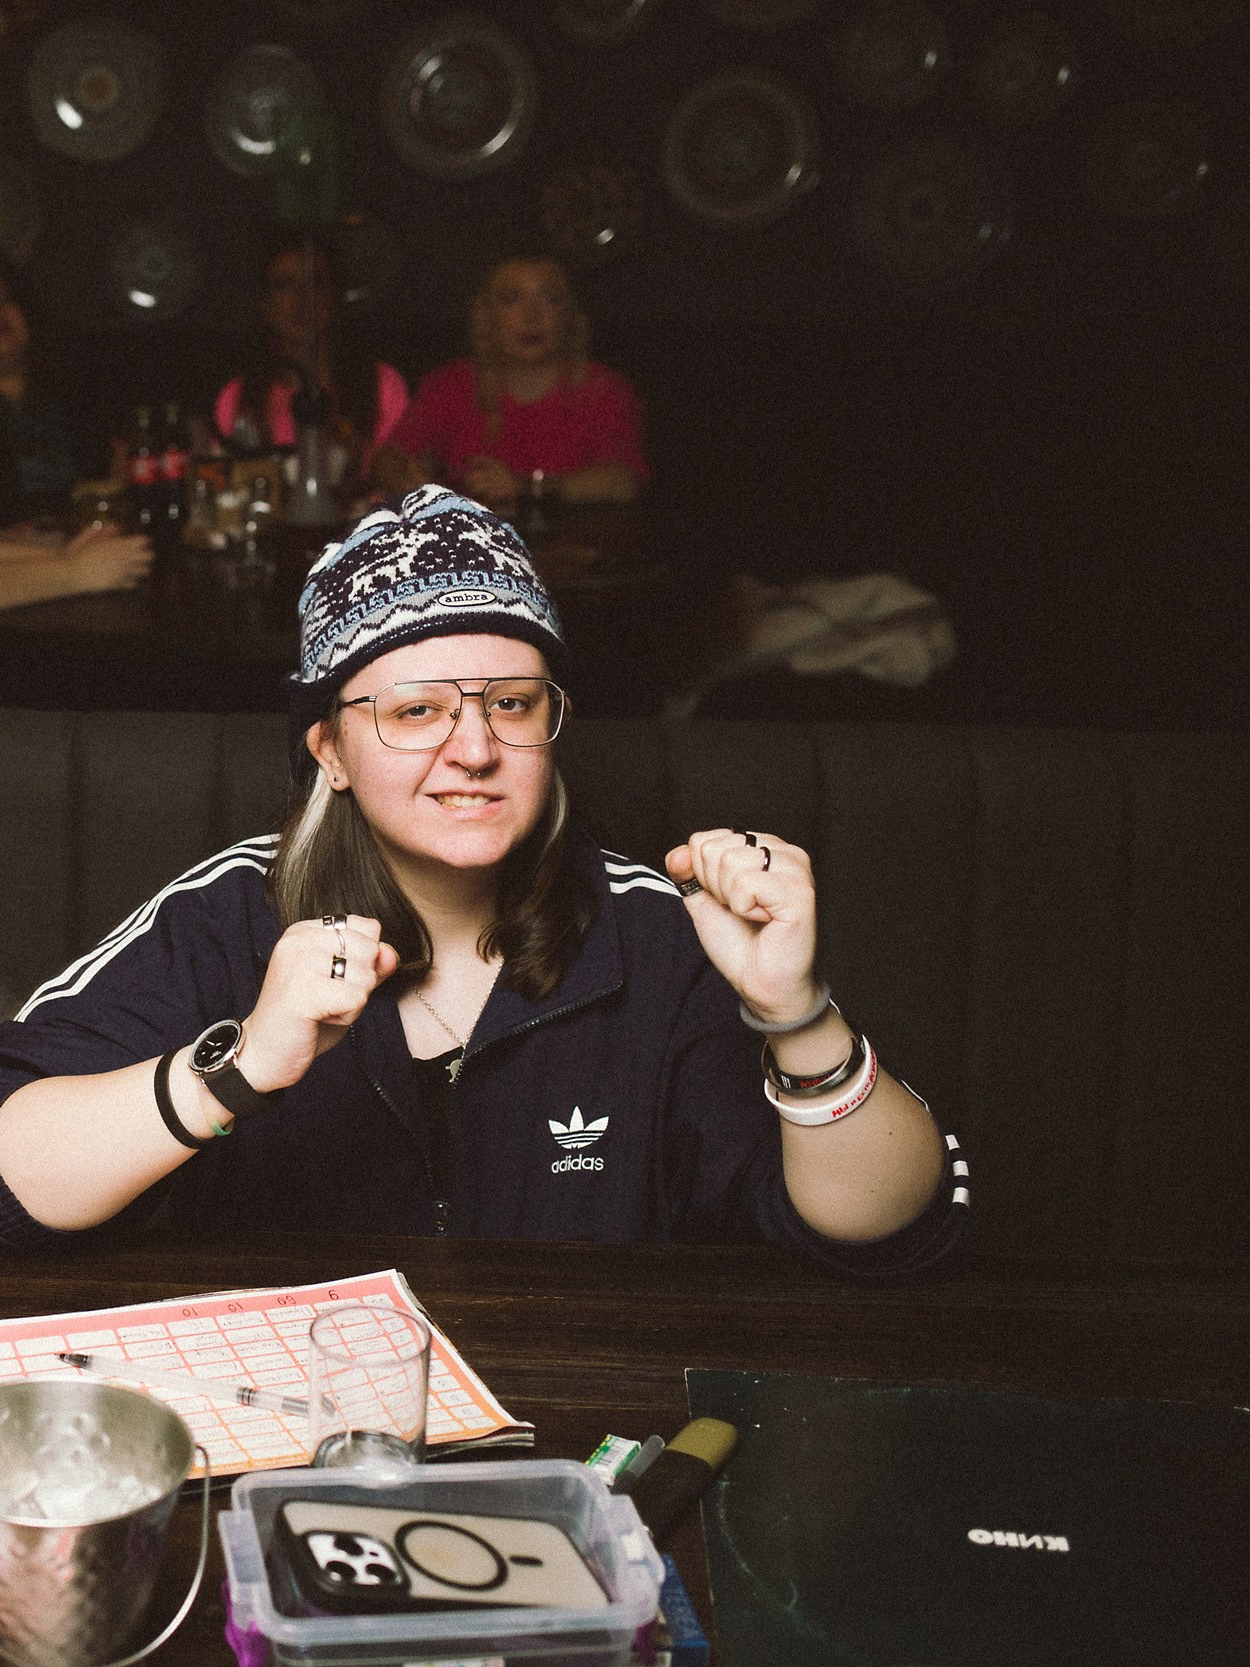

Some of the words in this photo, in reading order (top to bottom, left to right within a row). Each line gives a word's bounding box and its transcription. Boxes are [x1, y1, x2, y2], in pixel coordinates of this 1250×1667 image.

[445, 593, 488, 603] ambra
[551, 1153, 605, 1174] adidas
[967, 1528, 1069, 1551] КИНО
